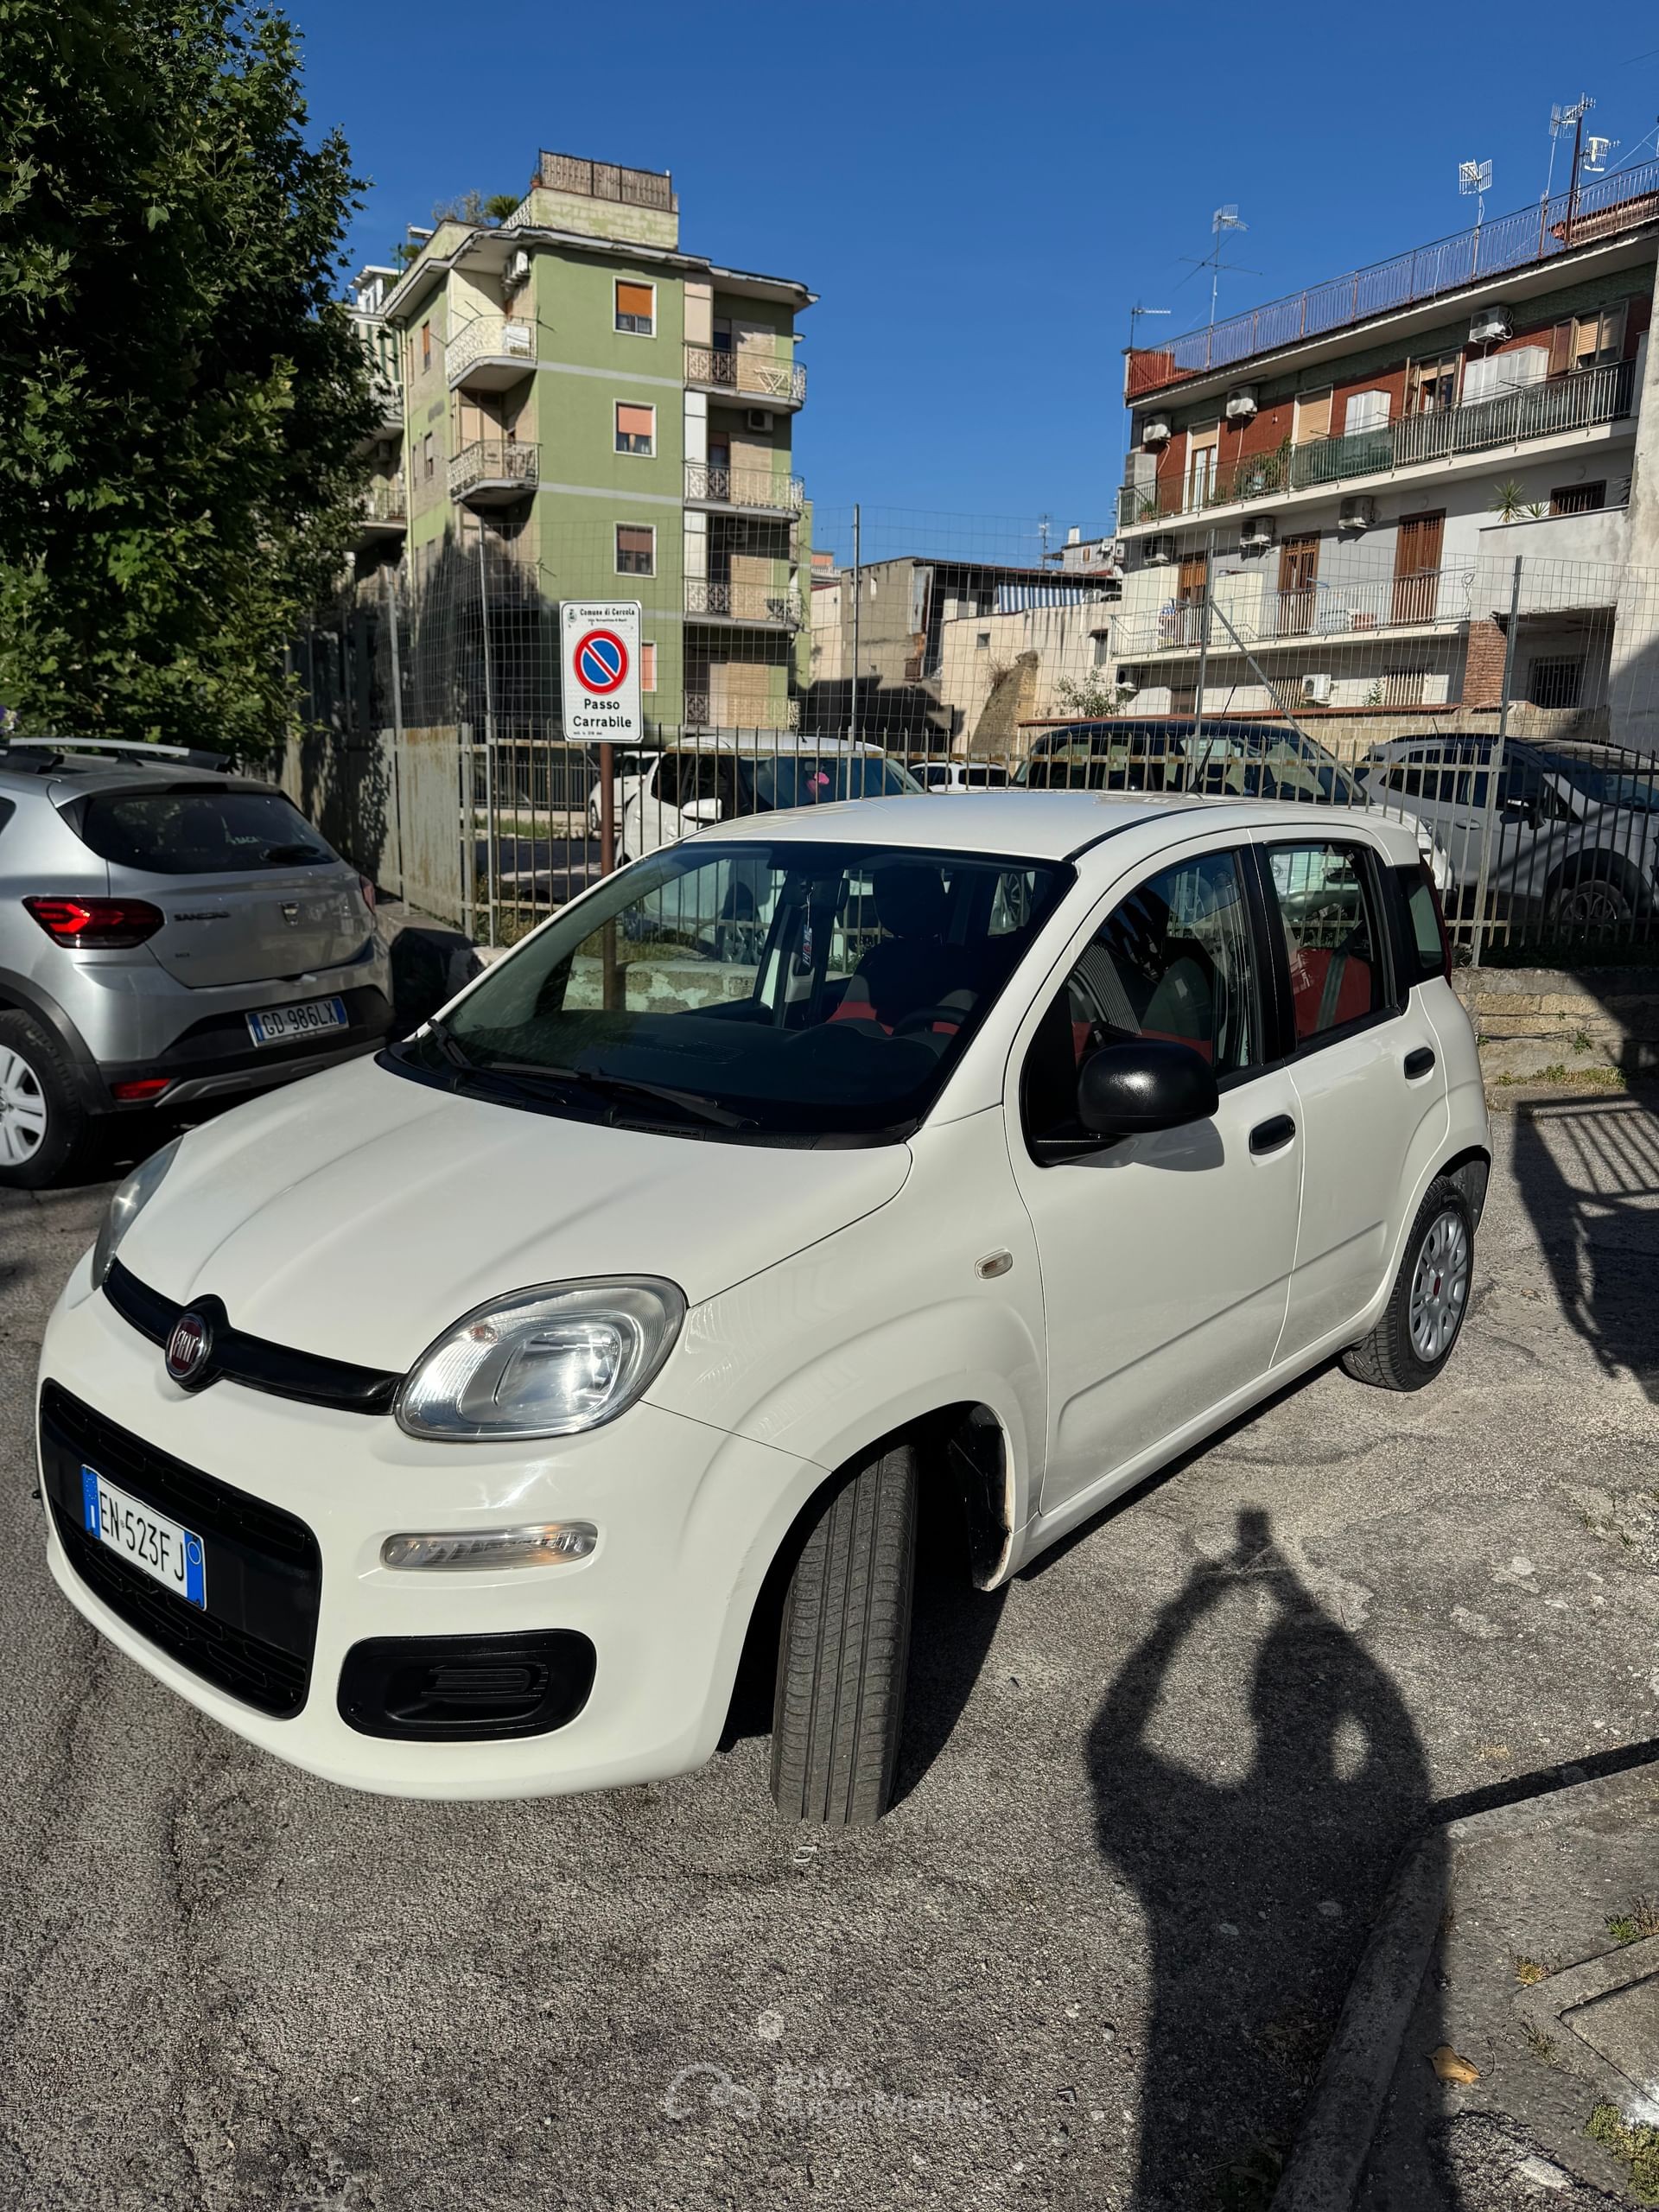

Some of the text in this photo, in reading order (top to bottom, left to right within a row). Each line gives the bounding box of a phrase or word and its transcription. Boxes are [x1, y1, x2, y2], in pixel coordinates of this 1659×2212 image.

[584, 698, 620, 709] Passo
[573, 715, 632, 728] Carrabile
[262, 1012, 285, 1036] GD
[287, 1002, 338, 1030] 986LX
[173, 1330, 200, 1363] FIAT
[99, 1489, 120, 1541] EN
[125, 1510, 185, 1582] 523FJ
